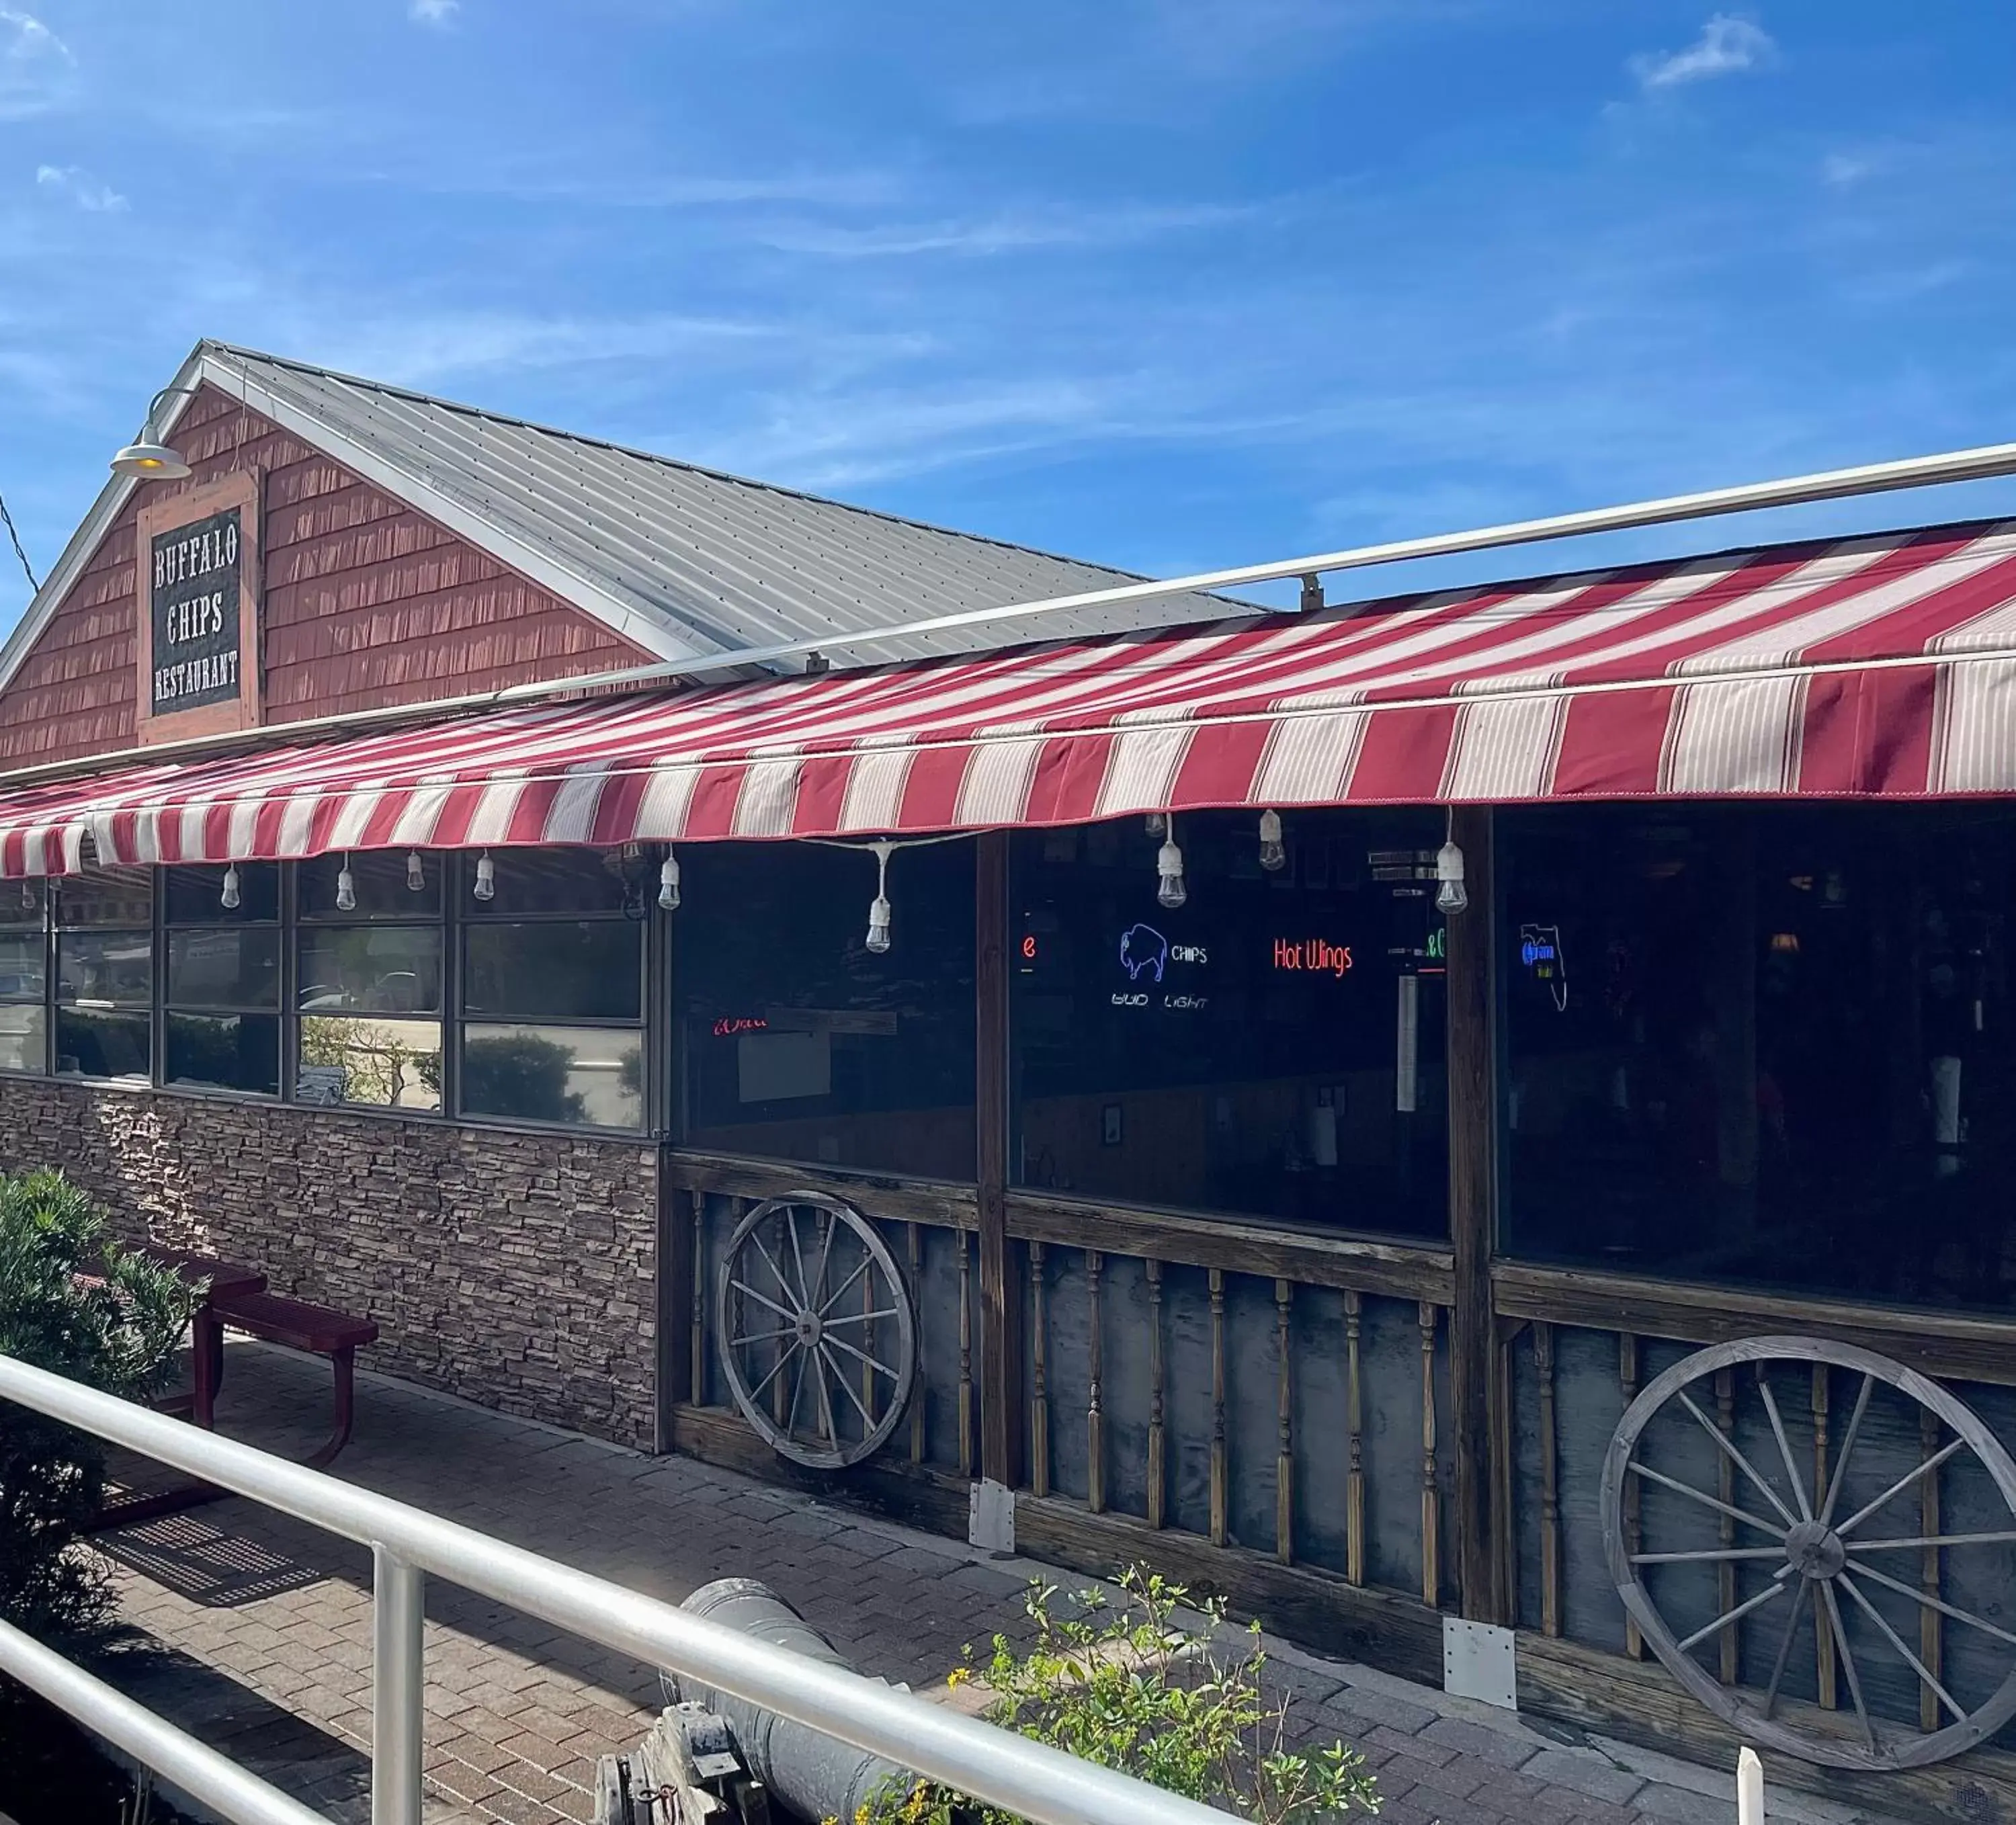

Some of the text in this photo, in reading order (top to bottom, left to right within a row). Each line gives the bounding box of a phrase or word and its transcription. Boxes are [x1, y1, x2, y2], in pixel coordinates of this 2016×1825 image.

[155, 523, 237, 589] BUFFALO
[167, 591, 222, 645] CHIPS
[155, 650, 237, 701] RESTAURANT
[1171, 945, 1208, 964] CHIPS
[1275, 938, 1353, 978] Hot Wings
[1111, 994, 1209, 1009] BUD LIGHT
